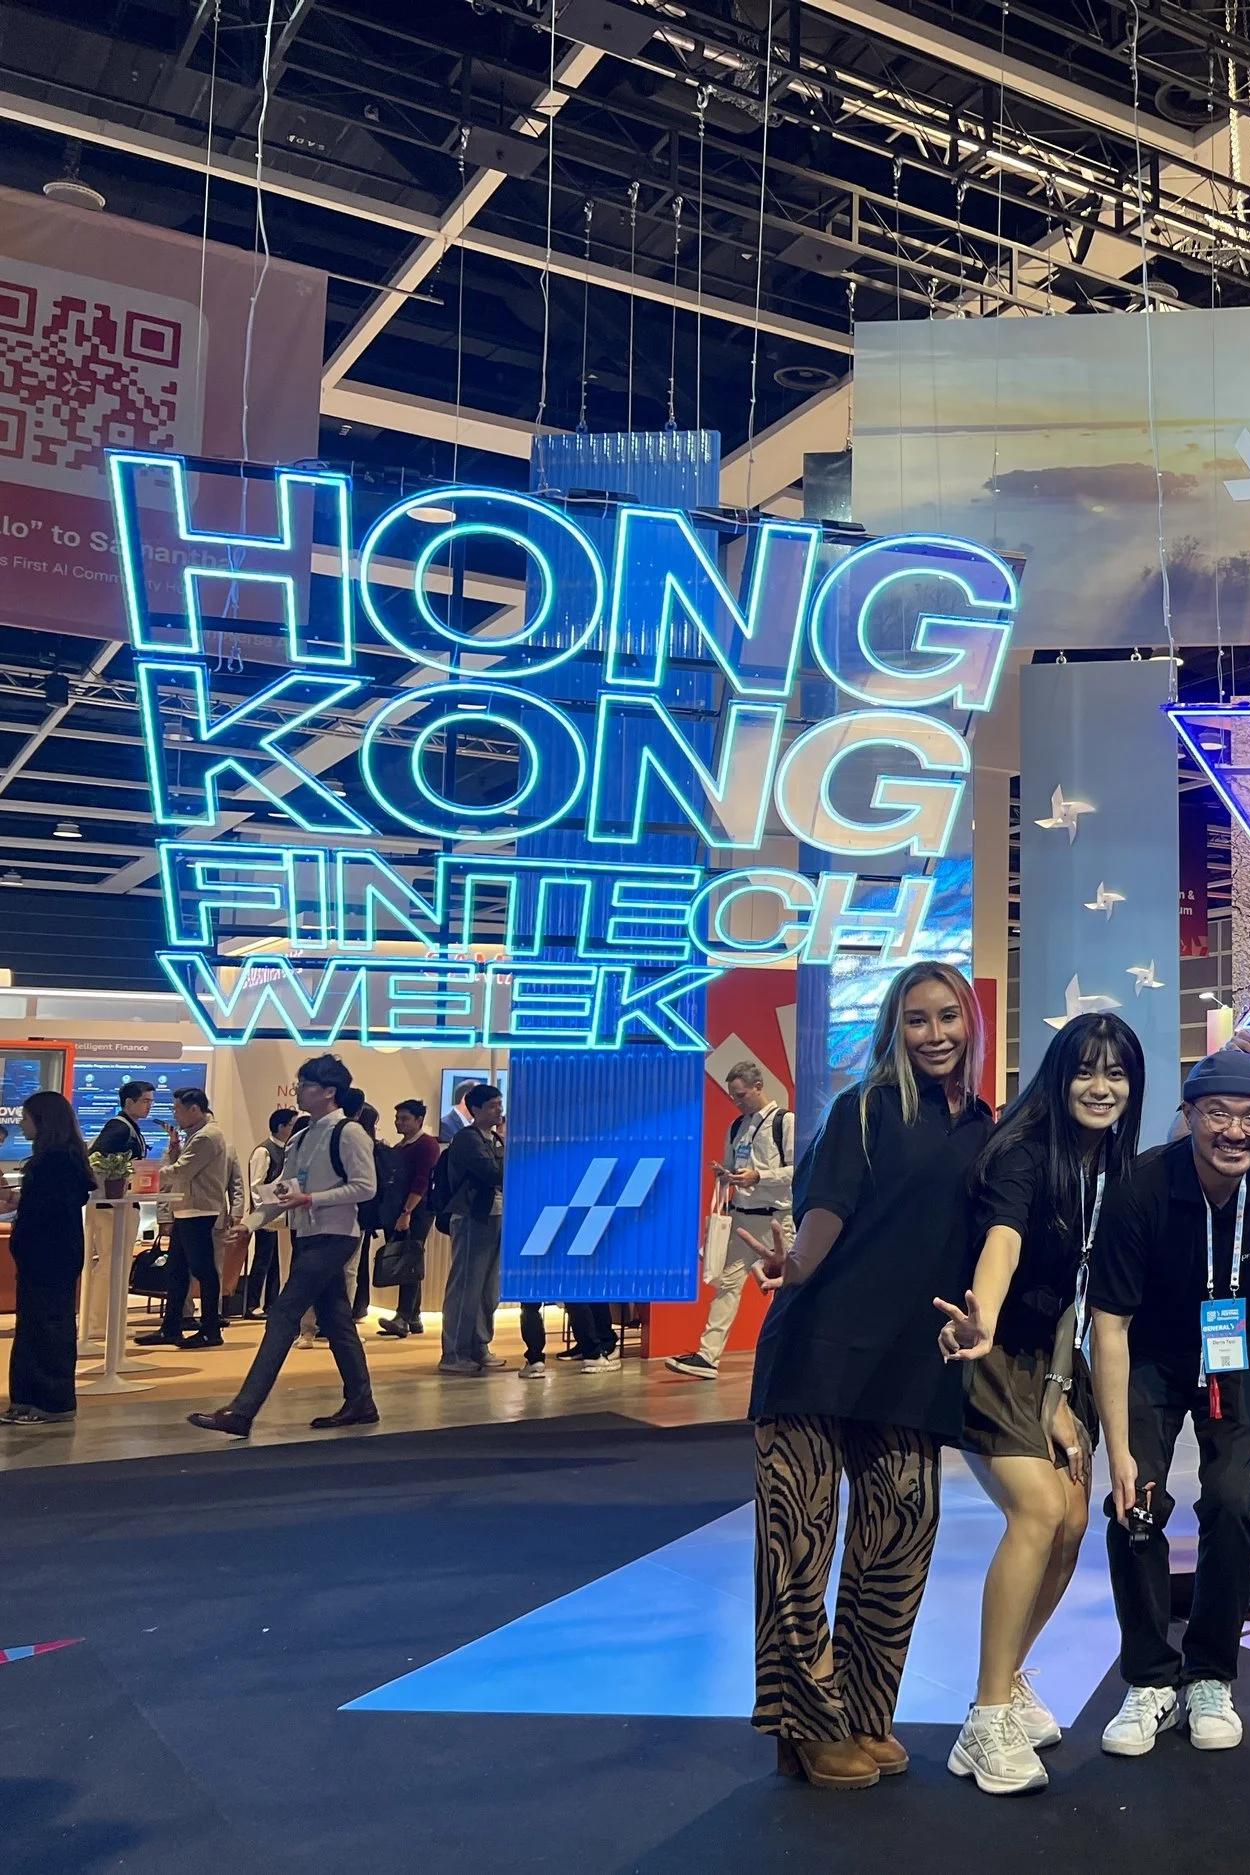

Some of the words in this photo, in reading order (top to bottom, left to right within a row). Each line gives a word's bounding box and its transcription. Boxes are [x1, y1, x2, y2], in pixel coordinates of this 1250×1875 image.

[0, 516, 43, 539] lo”
[51, 524, 81, 548] to
[13, 556, 49, 574] First
[52, 561, 68, 576] AI
[108, 448, 1019, 713] HONG
[136, 659, 973, 858] KONG
[157, 838, 936, 967] FINTECH
[155, 950, 726, 1052] WEEK
[74, 1042, 113, 1052] telligent
[115, 1043, 150, 1052] Finance
[1202, 1324, 1231, 1333] GENERAL
